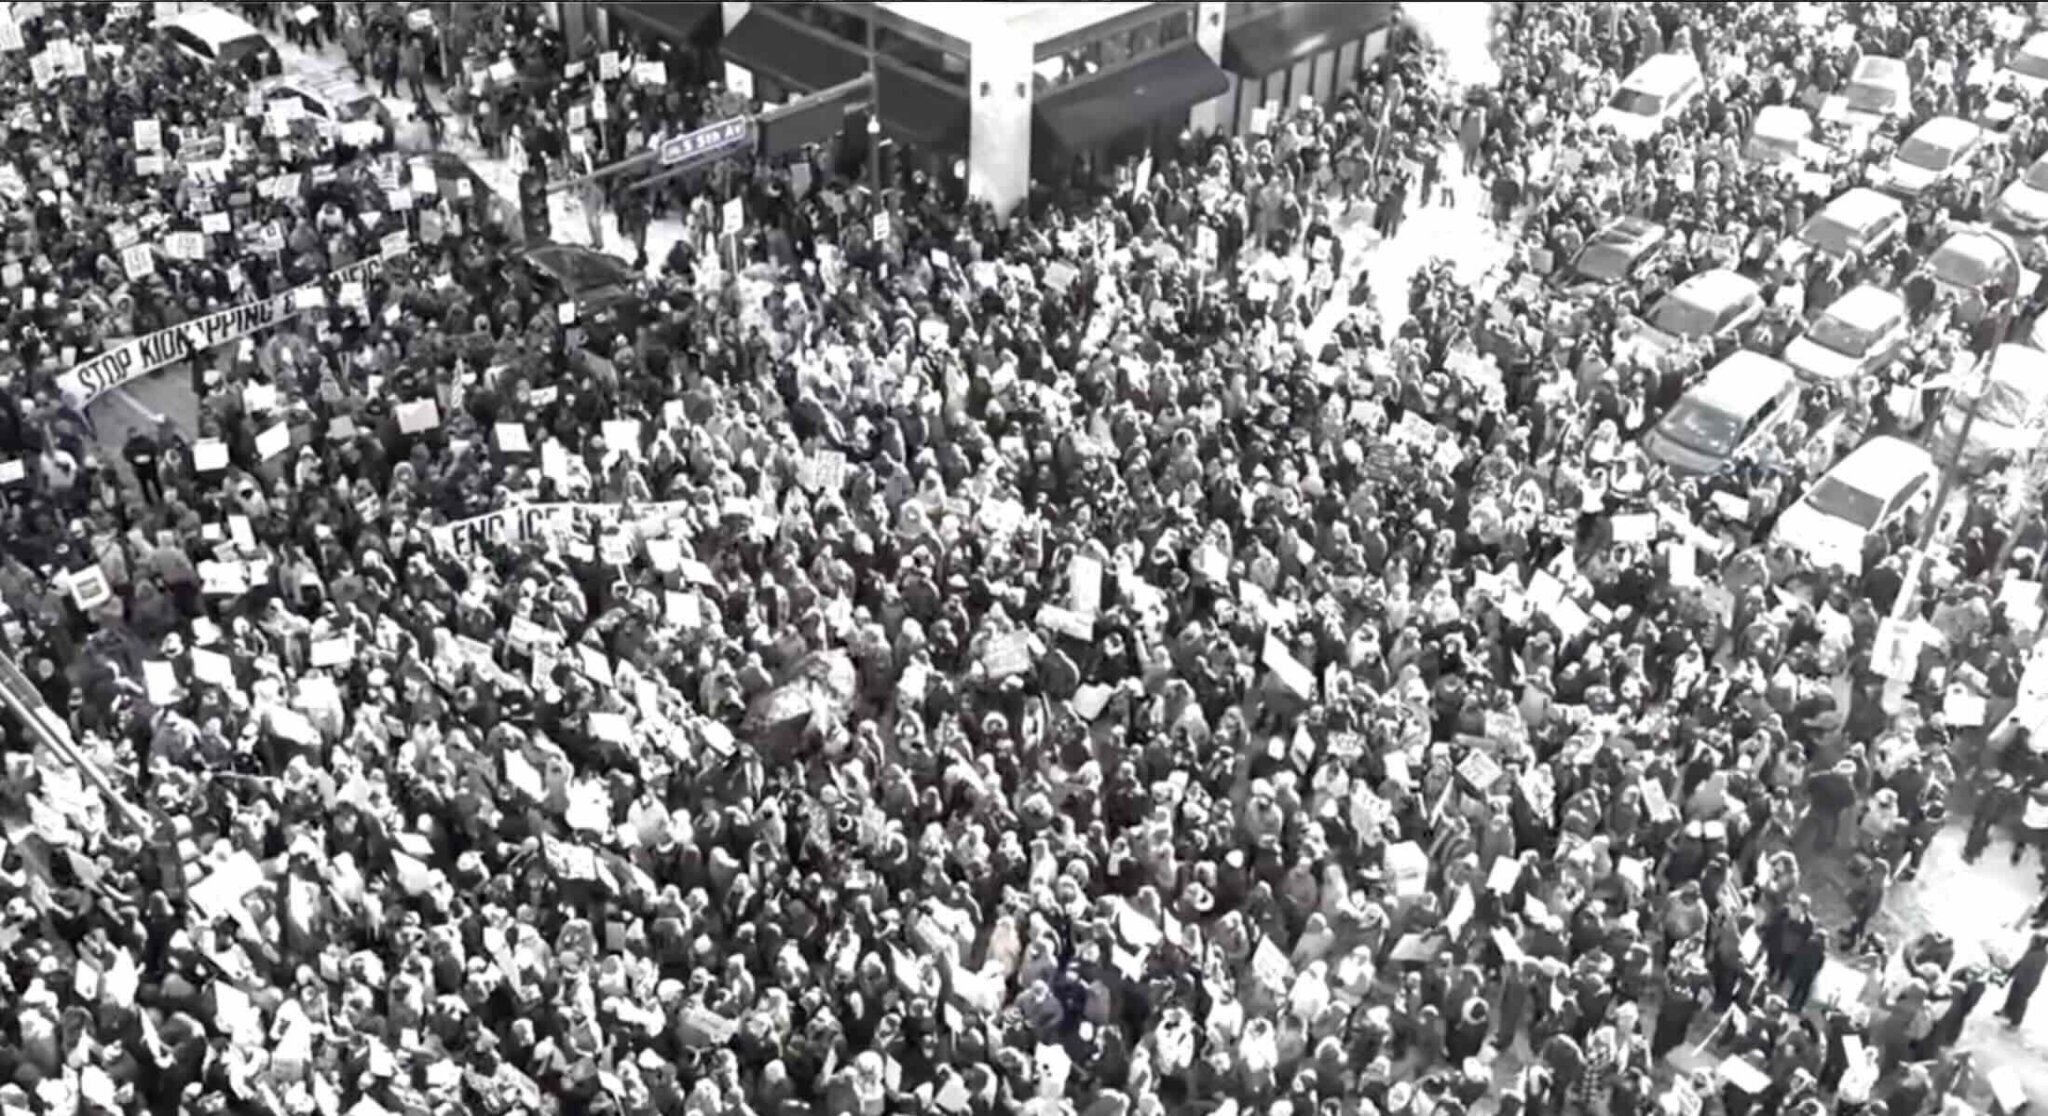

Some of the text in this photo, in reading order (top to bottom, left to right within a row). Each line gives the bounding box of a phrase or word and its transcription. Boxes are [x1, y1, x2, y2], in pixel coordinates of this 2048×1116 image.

[78, 347, 132, 399] STOP
[139, 301, 274, 369] KIDNPPING
[453, 514, 505, 557] END
